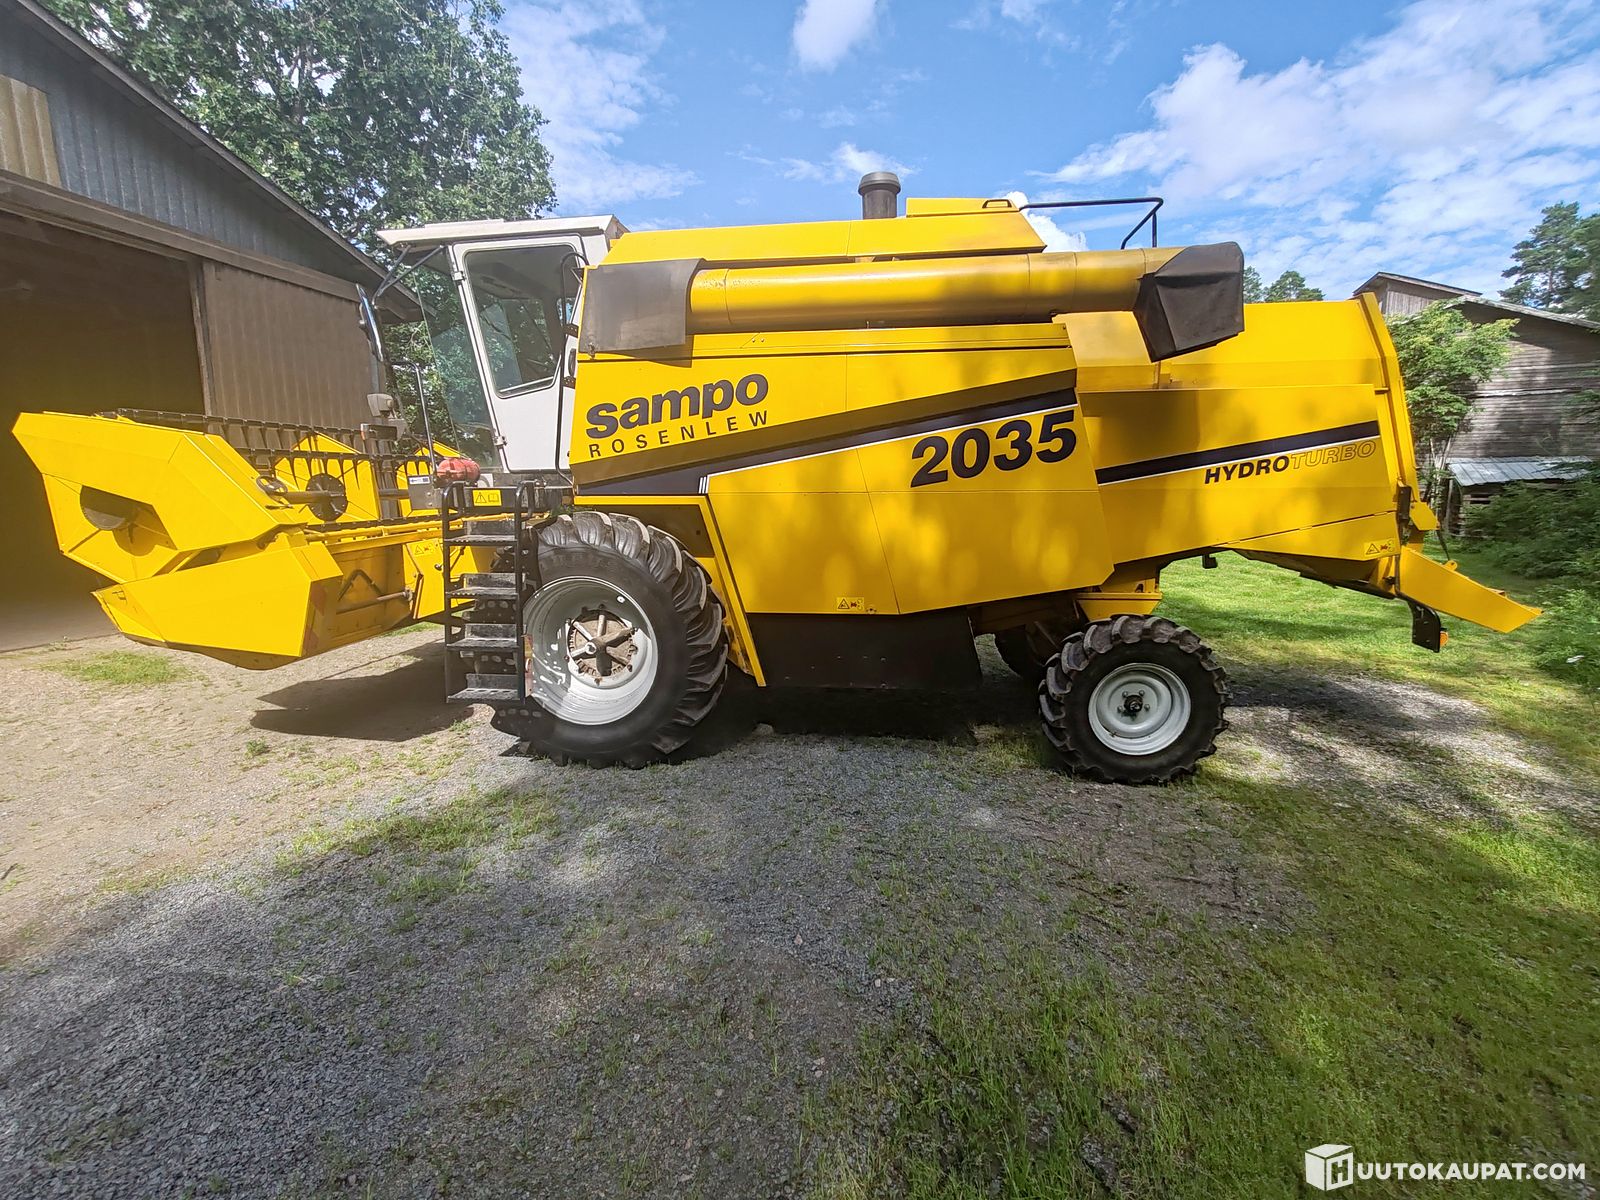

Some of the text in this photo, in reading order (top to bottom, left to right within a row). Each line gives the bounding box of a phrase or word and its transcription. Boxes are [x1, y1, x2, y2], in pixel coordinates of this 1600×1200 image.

[586, 373, 769, 438] sampo
[588, 410, 768, 458] ROSENLEW
[910, 409, 1077, 488] 2035
